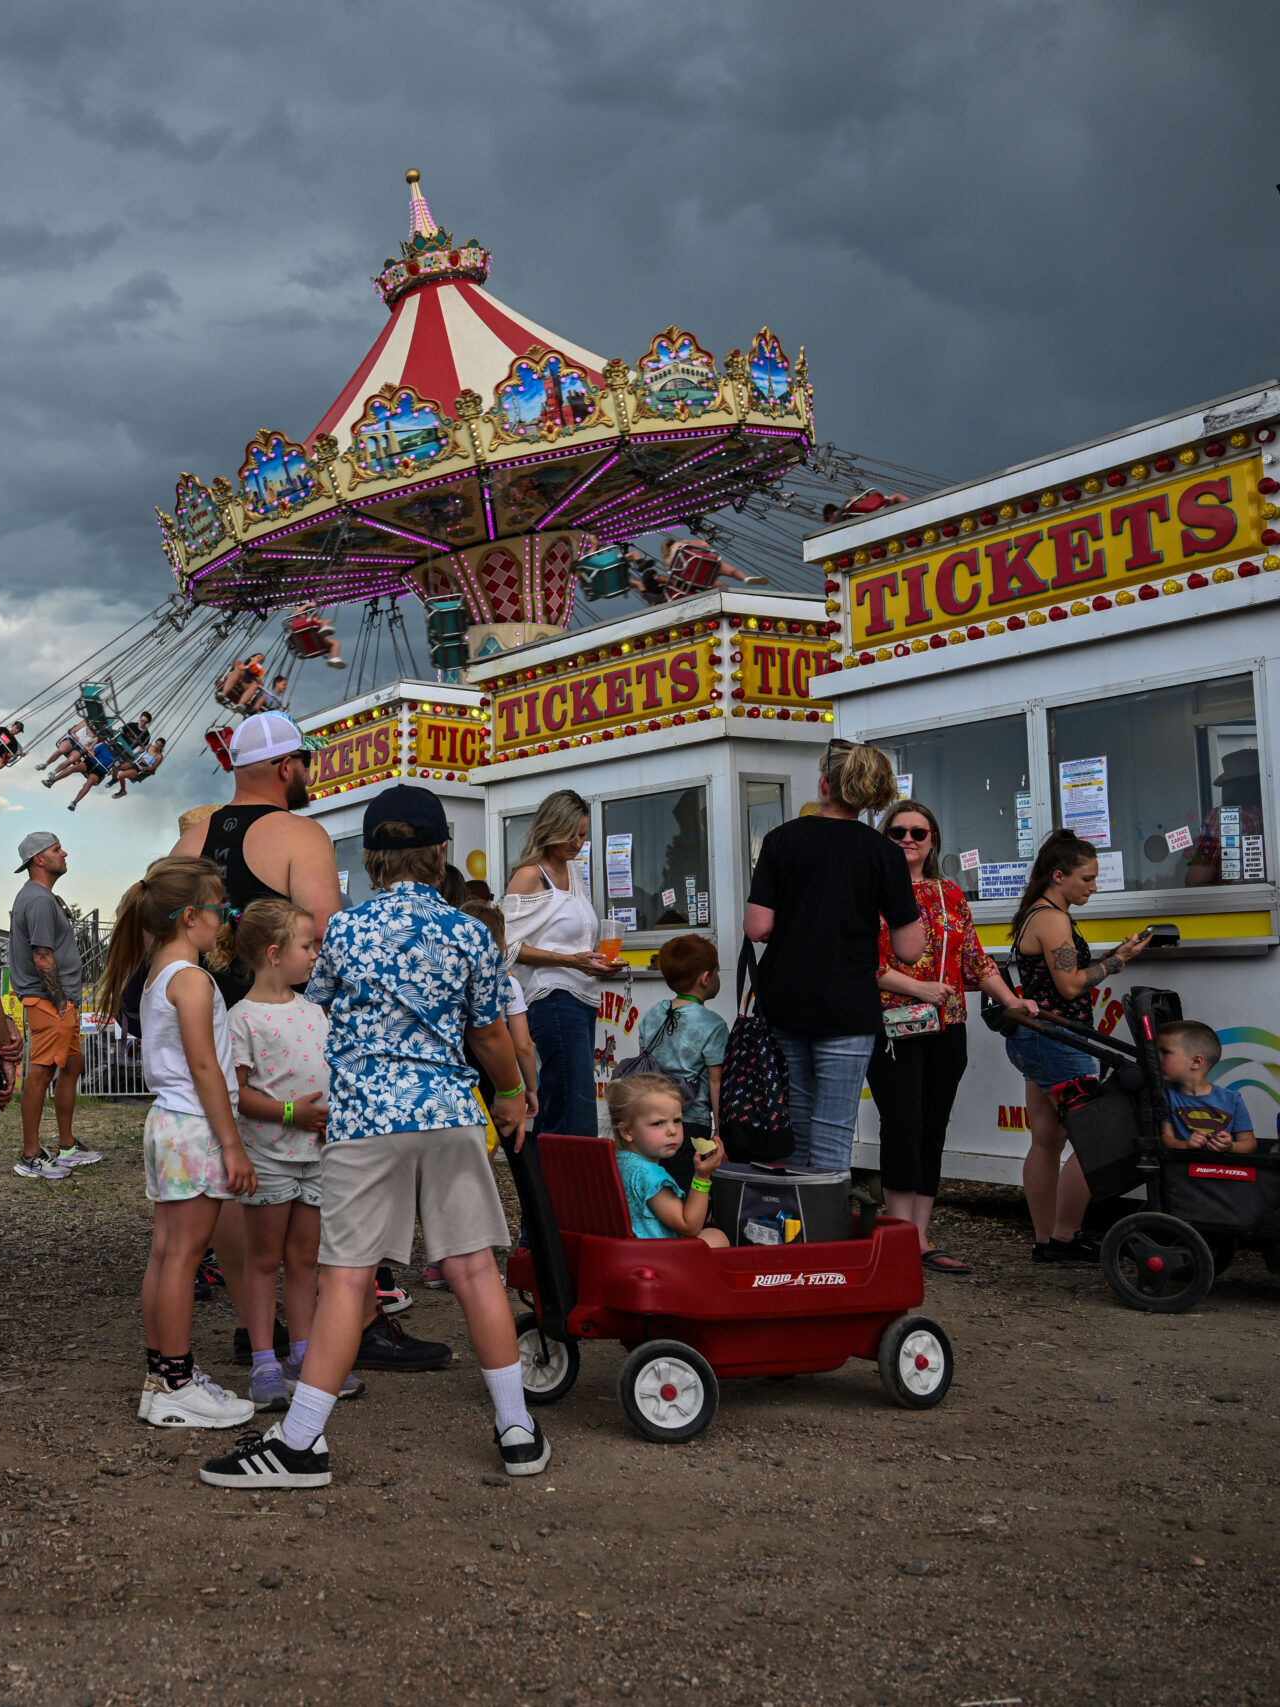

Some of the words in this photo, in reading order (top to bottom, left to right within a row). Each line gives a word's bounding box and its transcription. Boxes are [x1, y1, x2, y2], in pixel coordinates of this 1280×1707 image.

[856, 475, 1237, 636] TICKETS
[498, 650, 699, 742] TICKETS
[428, 724, 483, 766] TIC
[1171, 836, 1188, 844] CARDS
[1176, 840, 1190, 848] CASH
[752, 1274, 792, 1287] RADIO
[806, 1273, 846, 1285] FLYER
